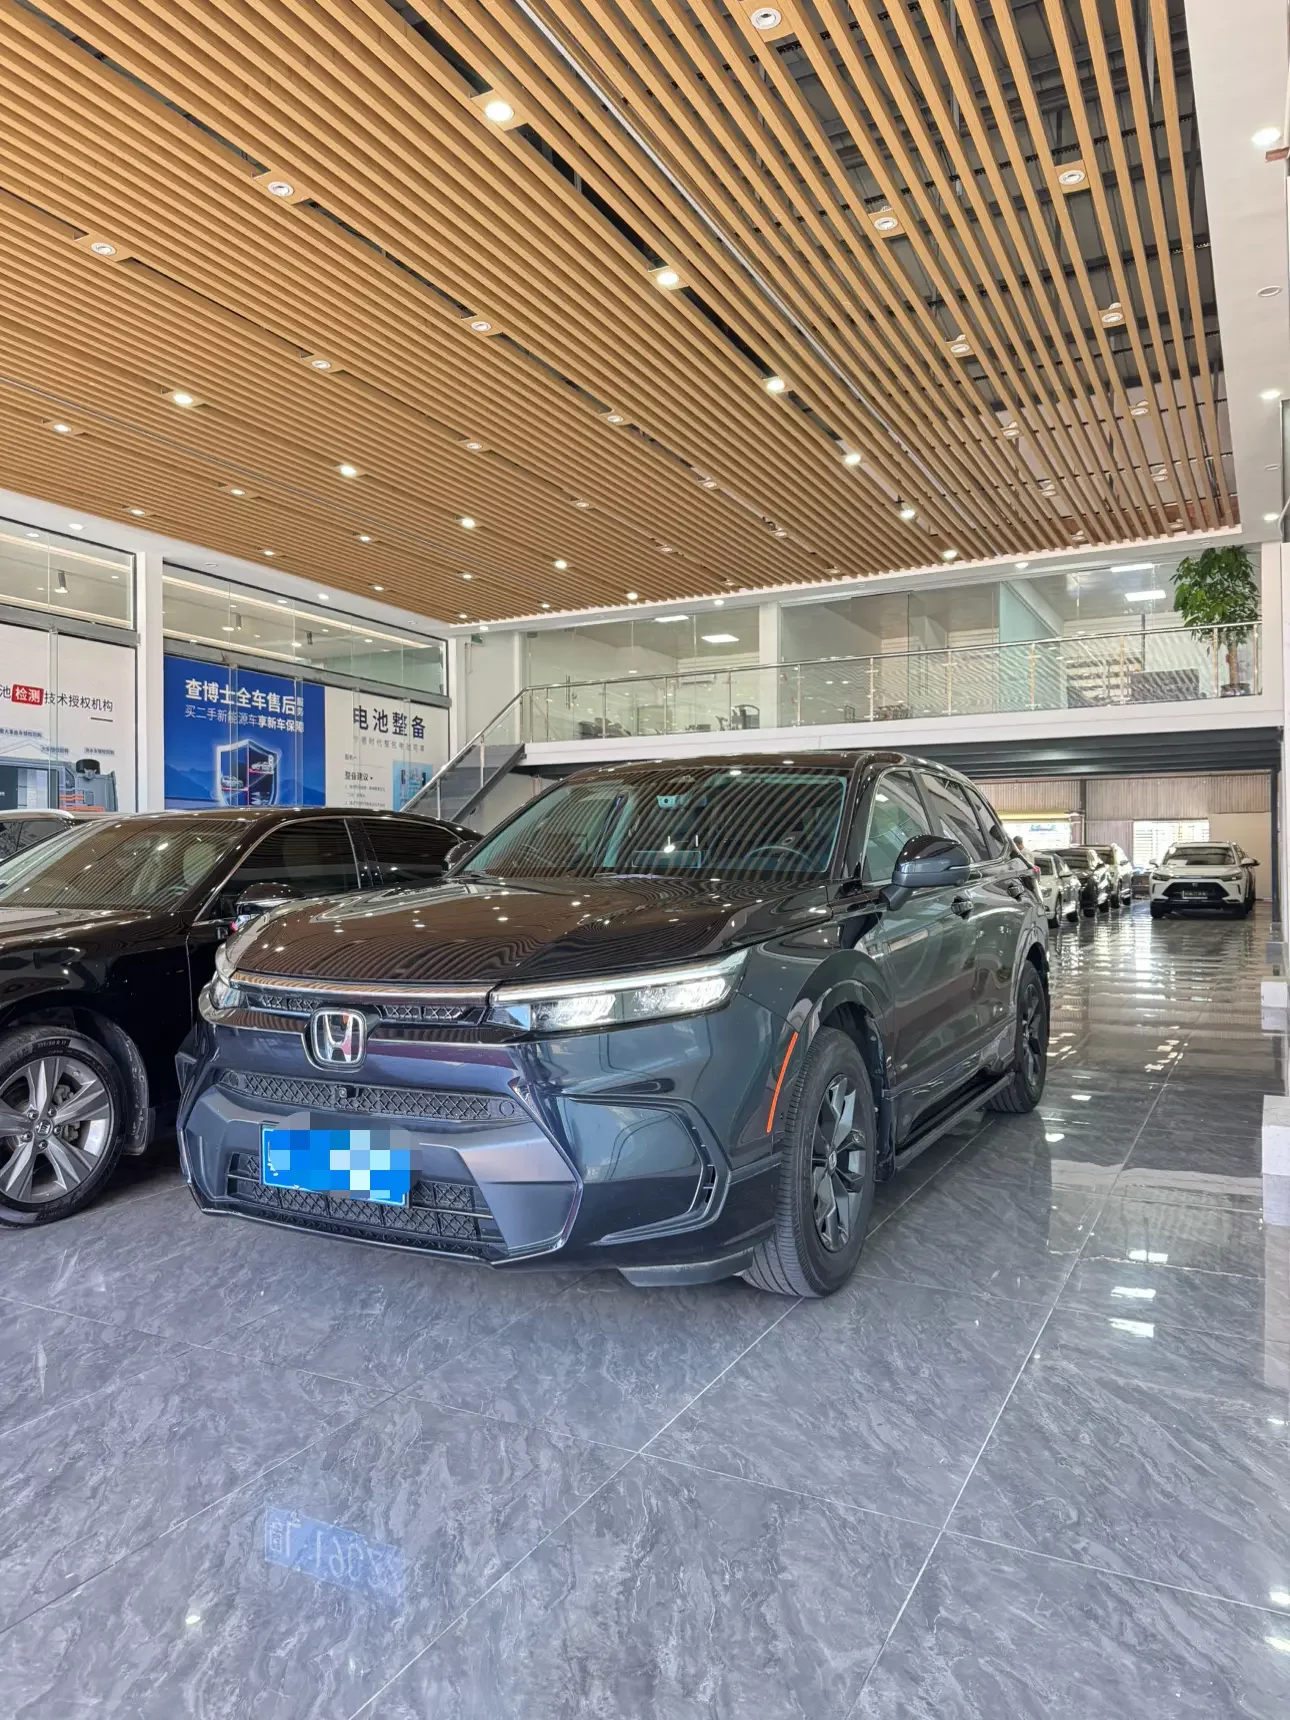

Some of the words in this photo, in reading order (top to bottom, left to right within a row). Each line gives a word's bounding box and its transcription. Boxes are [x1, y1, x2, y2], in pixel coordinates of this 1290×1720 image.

[185, 678, 296, 715] 查博士全车售后
[185, 704, 304, 733] 买二手新能源车享新车保障
[353, 705, 425, 739] 电池整备
